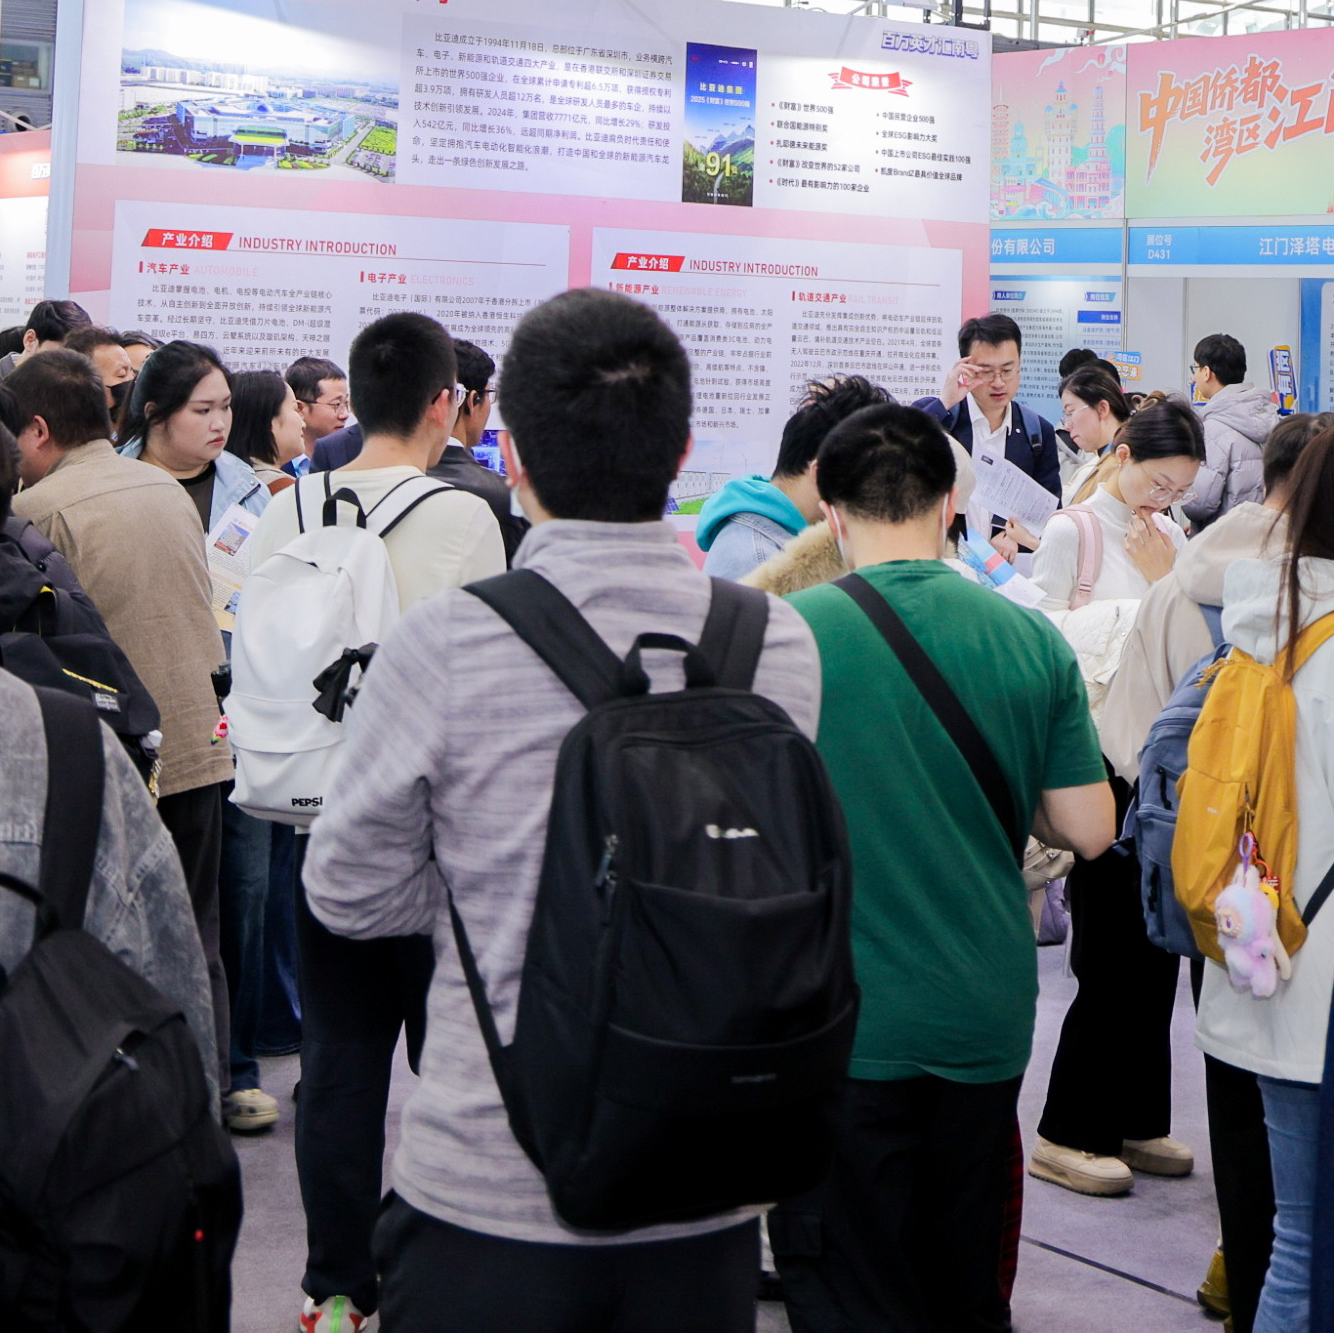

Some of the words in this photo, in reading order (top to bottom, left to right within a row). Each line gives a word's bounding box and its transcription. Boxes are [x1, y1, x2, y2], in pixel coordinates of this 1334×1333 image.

[880, 30, 980, 59] 百万英才汇南粤
[1138, 54, 1283, 185] 中国侨都
[162, 232, 213, 248] 产业介绍
[239, 236, 302, 251] INDUSTRY
[305, 240, 396, 256] INTRODUCTION
[991, 237, 1055, 256] 份有限公司
[1146, 233, 1172, 246] 展位号
[1148, 249, 1170, 260] D431
[147, 262, 189, 275] 汽车产业
[194, 265, 259, 278] AUTOMOBILE
[627, 256, 669, 269] 产业介绍
[689, 259, 741, 273] INDUSTRY
[743, 263, 819, 277] INTRODUCTION
[368, 273, 406, 285] 电子产业
[410, 274, 475, 286] ELECTRONICS
[616, 283, 659, 295] 新能源产业
[798, 291, 847, 304] 轨道交通产业
[291, 796, 323, 807] PEPSI
